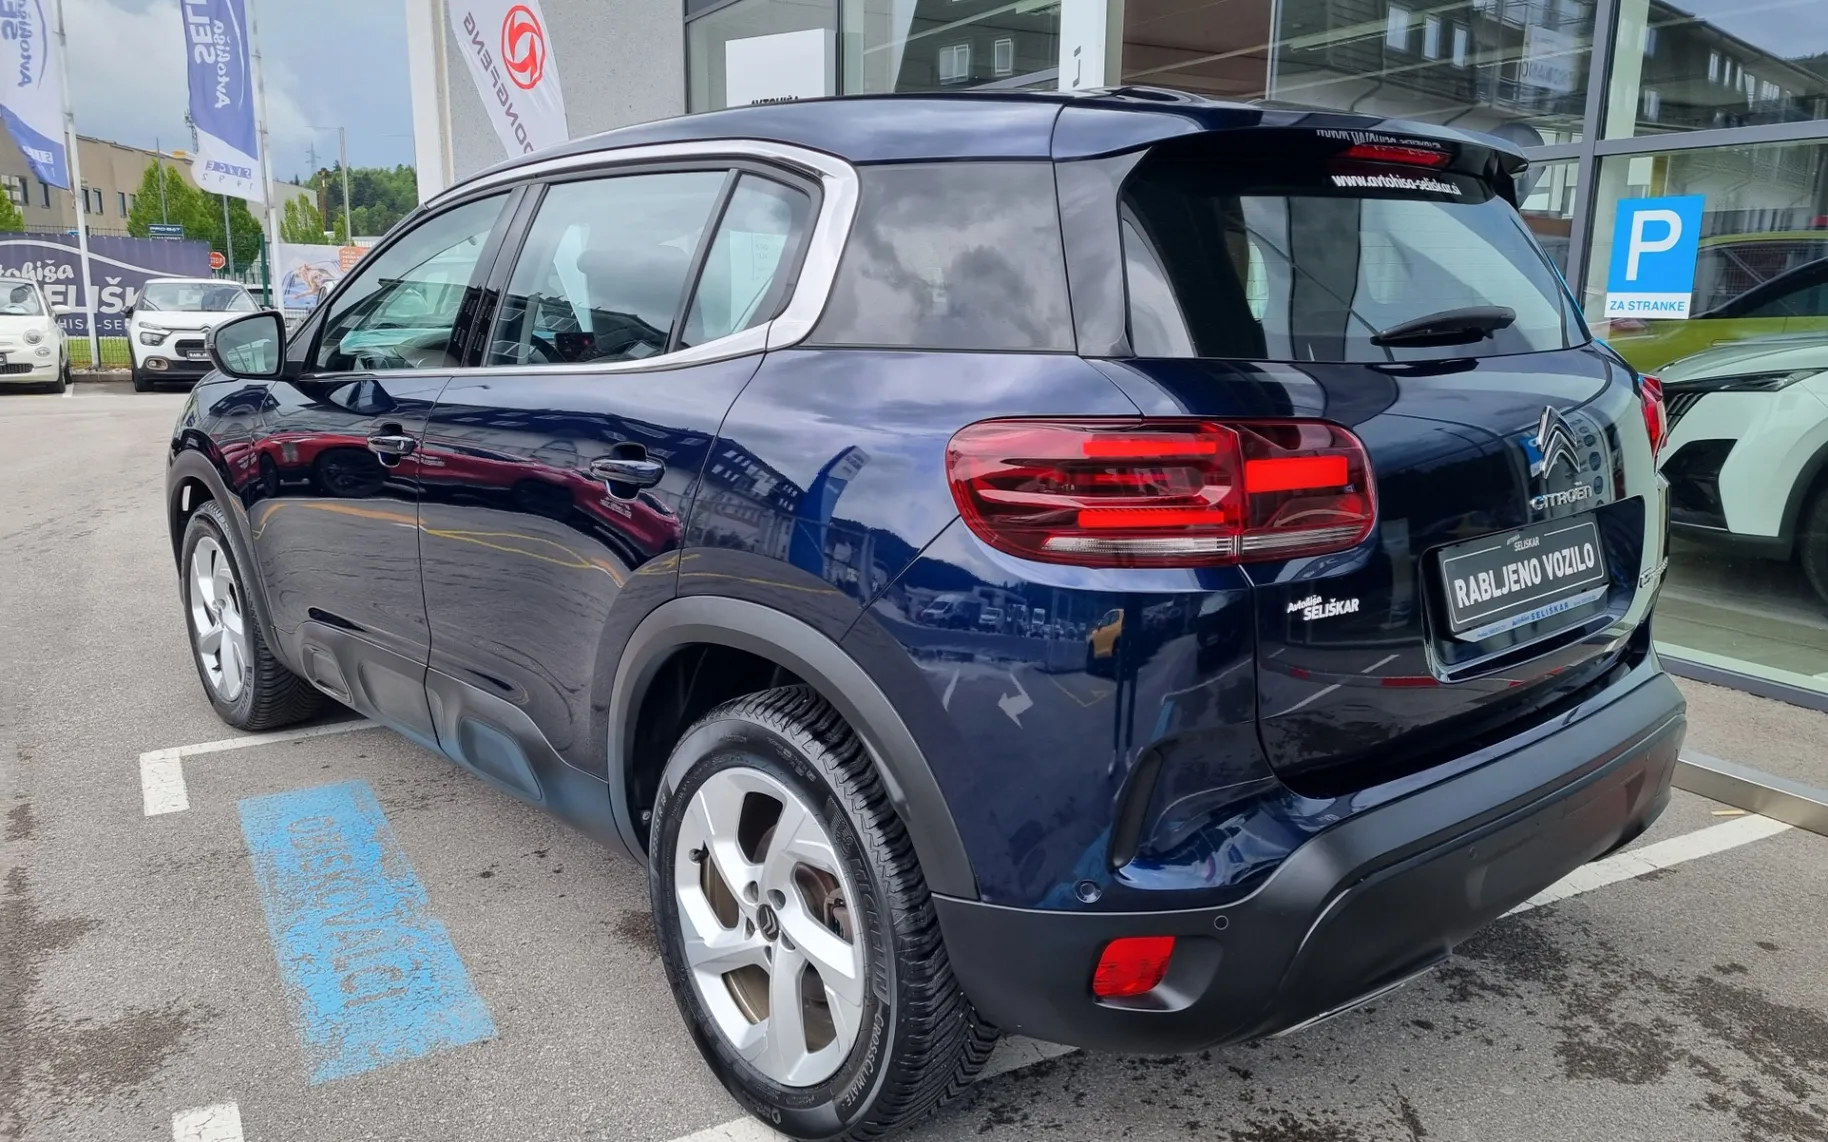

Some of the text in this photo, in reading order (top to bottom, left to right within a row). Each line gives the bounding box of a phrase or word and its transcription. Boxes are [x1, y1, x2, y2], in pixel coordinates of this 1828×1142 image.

[1331, 173, 1462, 196] www.avtohisa-seliskar.si
[1625, 209, 1683, 281] P
[43, 276, 142, 315] ELIŠK
[1609, 300, 1686, 312] ZA STRANKE
[1530, 481, 1593, 510] CITROËN
[1453, 558, 1542, 609] RABLJENO
[1542, 542, 1596, 581] VOZILO
[1303, 597, 1360, 621] SELIŠKAR
